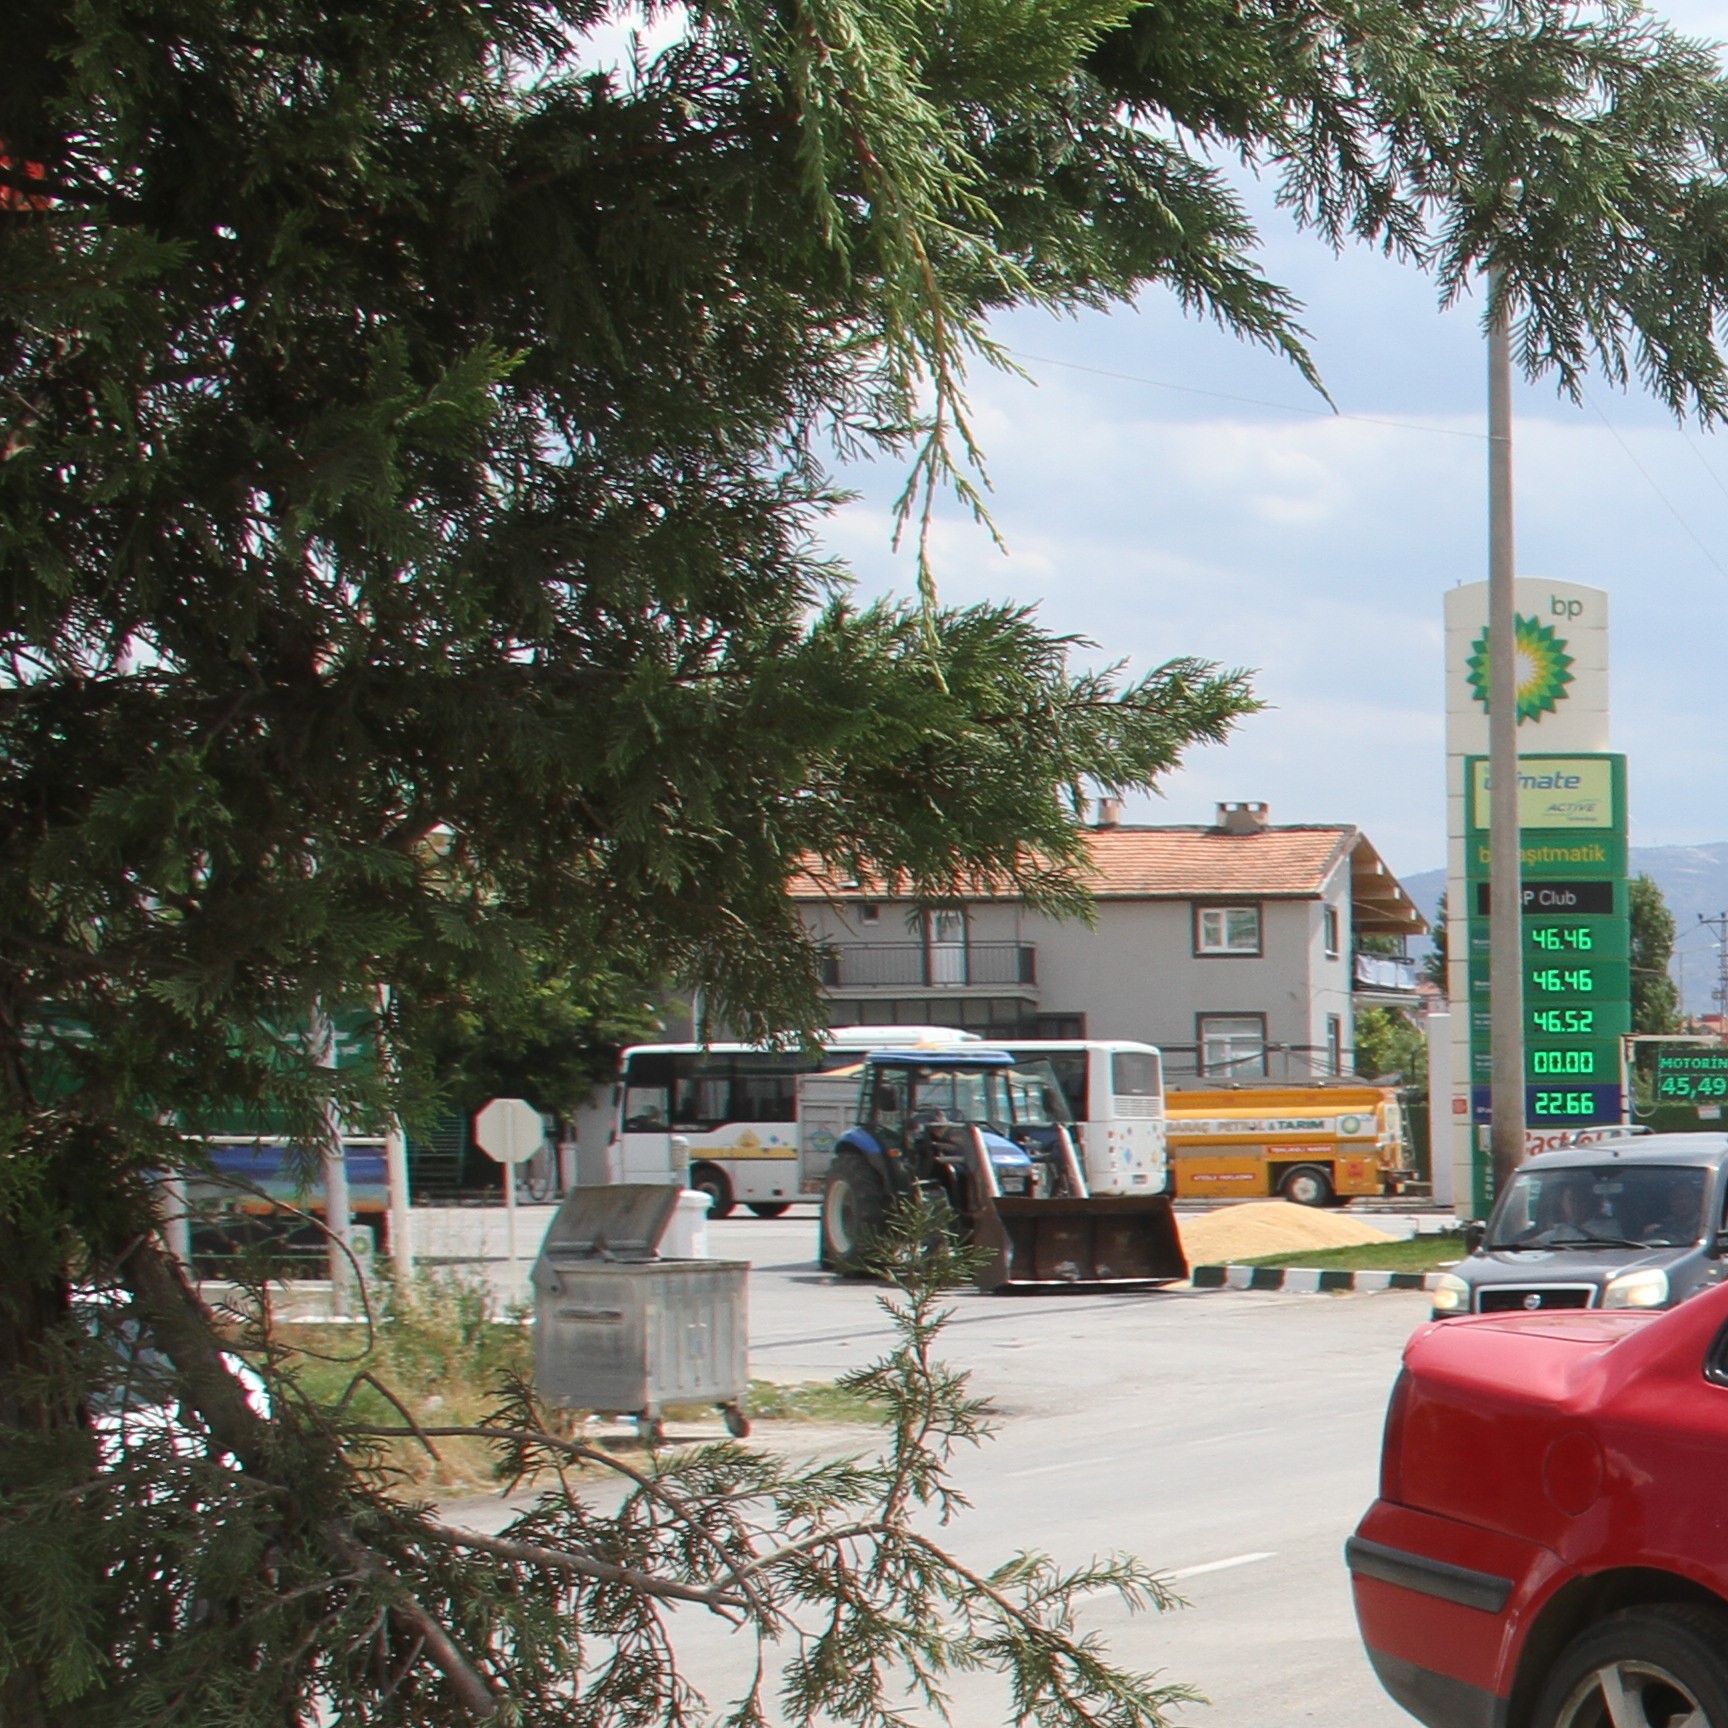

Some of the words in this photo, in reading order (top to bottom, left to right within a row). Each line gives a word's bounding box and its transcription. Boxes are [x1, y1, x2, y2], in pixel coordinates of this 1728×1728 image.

[1552, 594, 1583, 621] bp
[1539, 889, 1577, 906] Club
[1533, 928, 1592, 950] 46.46
[1533, 969, 1593, 991] 46.46
[1534, 1010, 1594, 1032] 46.52
[1534, 1051, 1594, 1073] 00.00
[1660, 1054, 1728, 1070] MOTORİN
[1661, 1077, 1728, 1099] 45,49
[1535, 1092, 1595, 1115] 22.66
